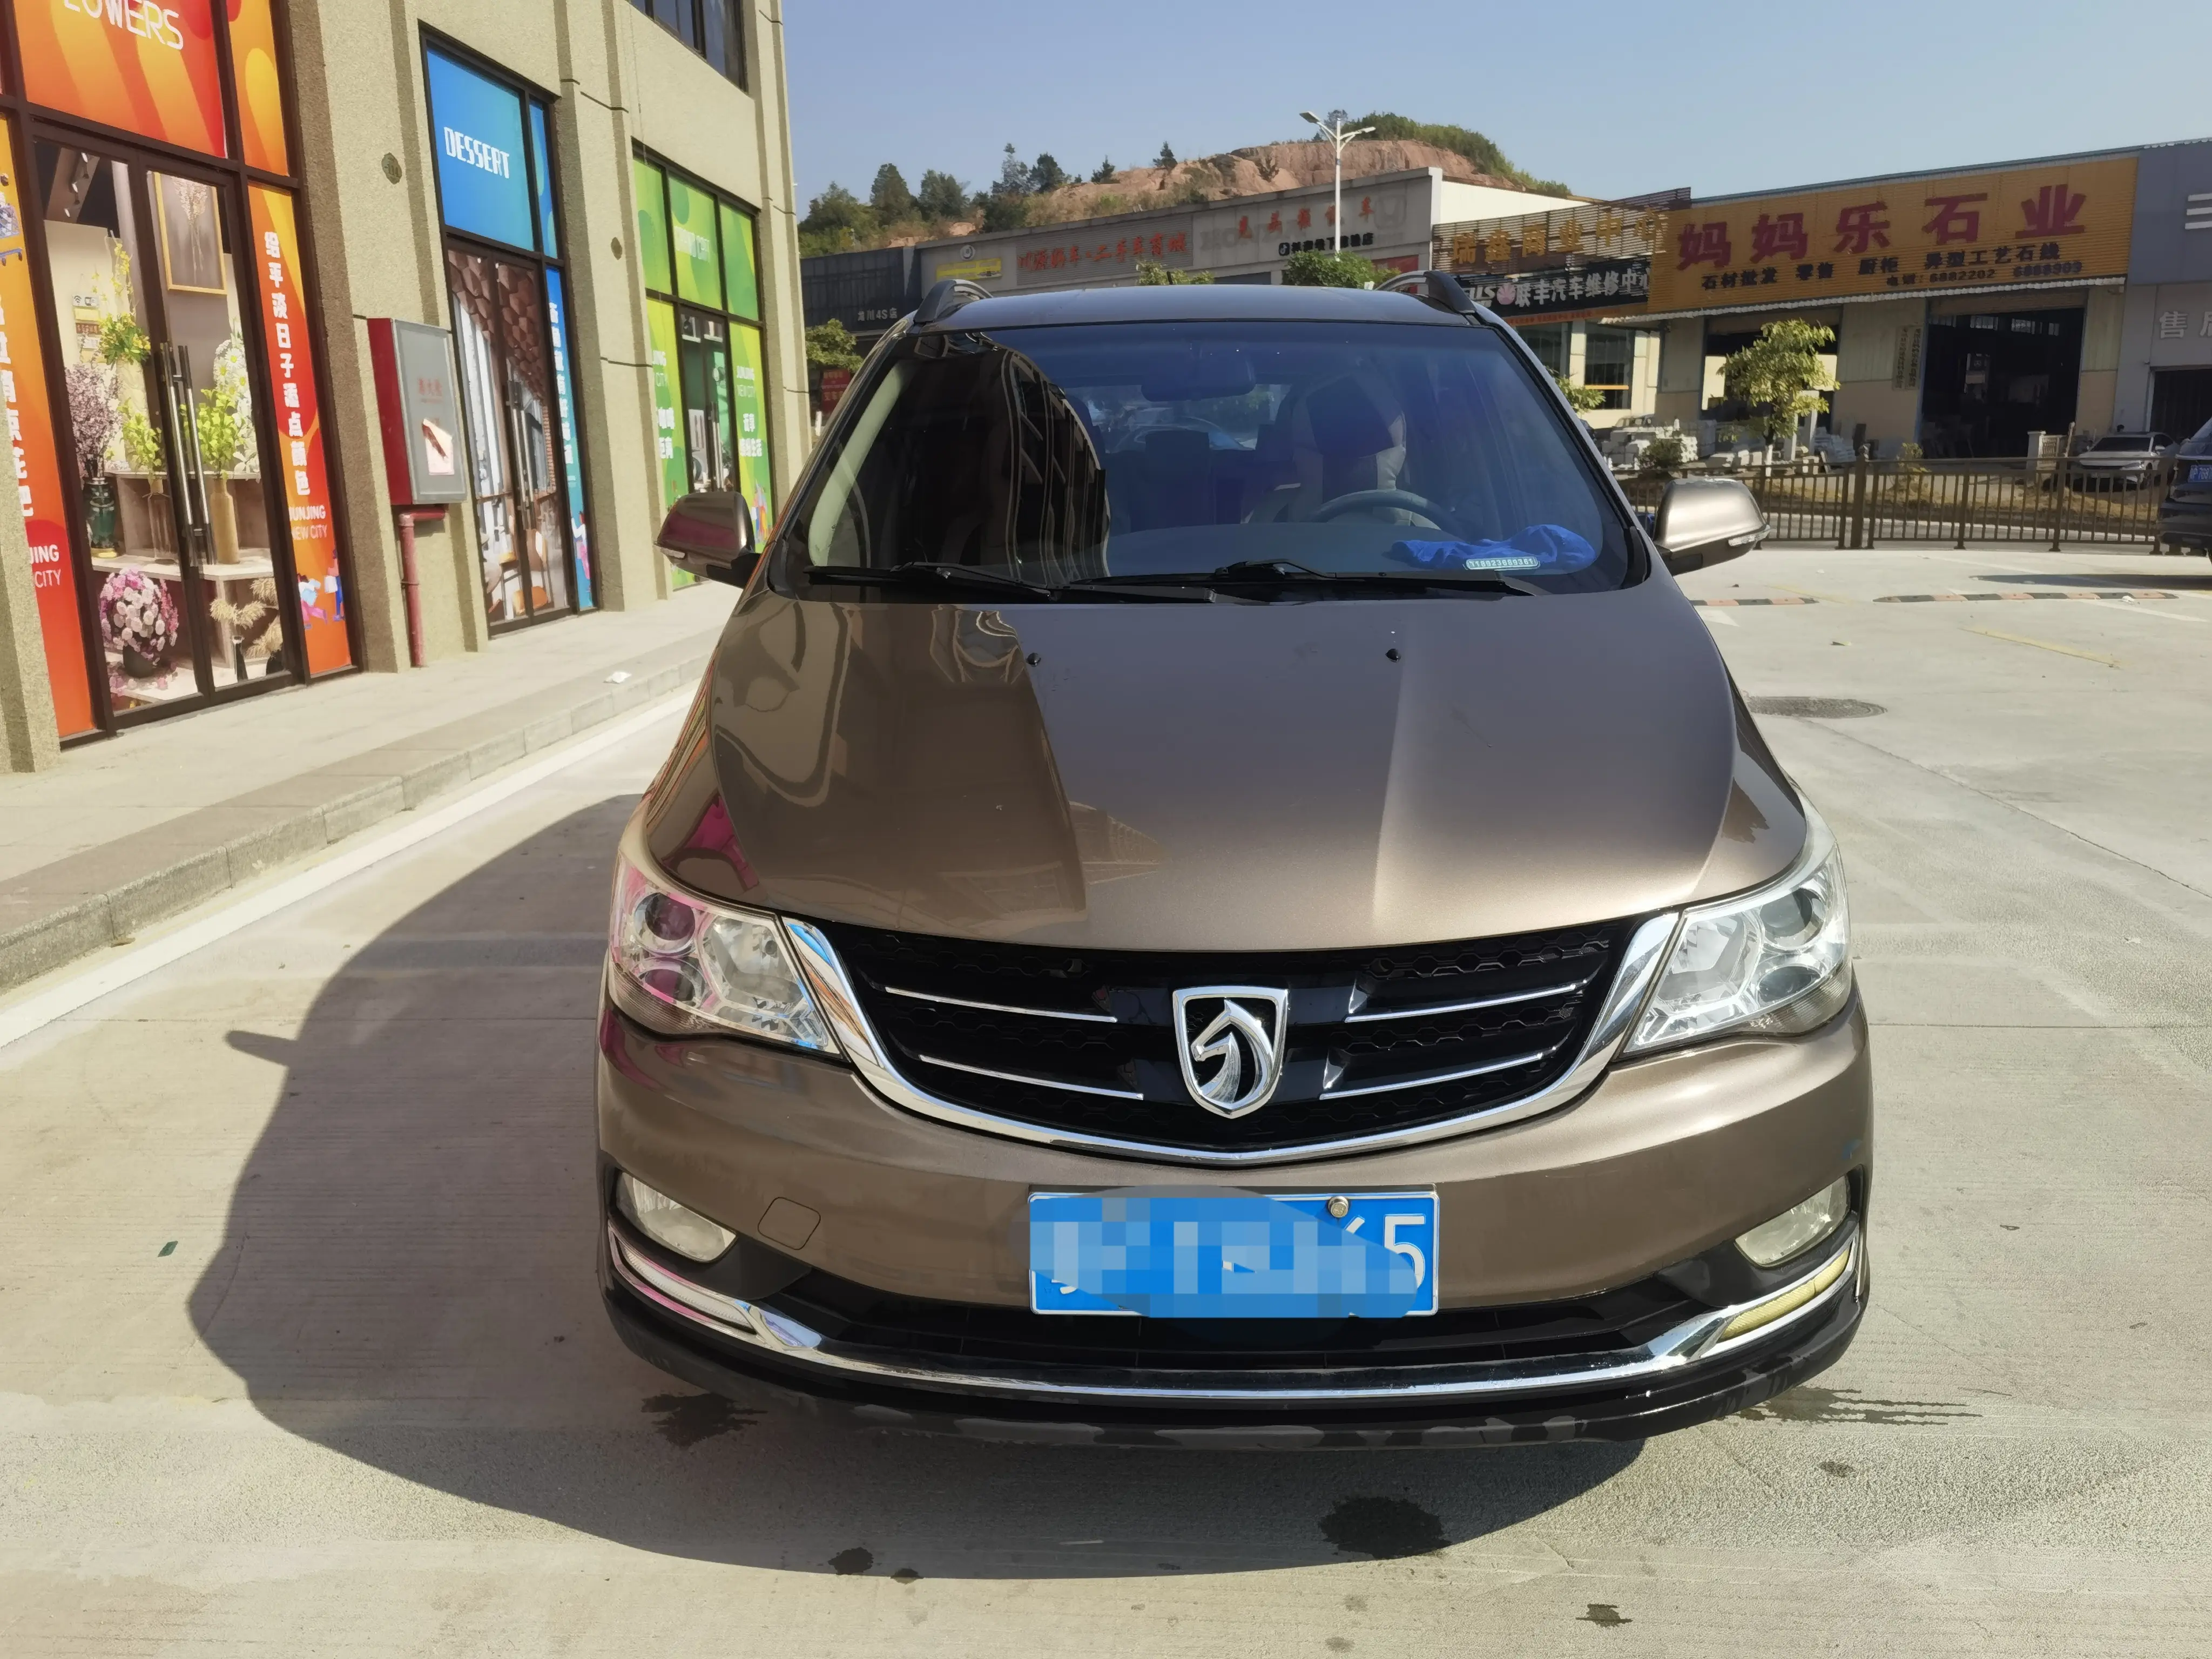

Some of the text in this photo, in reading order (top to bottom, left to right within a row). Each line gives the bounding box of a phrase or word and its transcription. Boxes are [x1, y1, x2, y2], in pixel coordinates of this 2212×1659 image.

[443, 126, 510, 179] DESSERT
[1676, 184, 2086, 271] 妈妈乐石业
[1702, 266, 1778, 289] 石材批发
[34, 569, 61, 588] CITY
